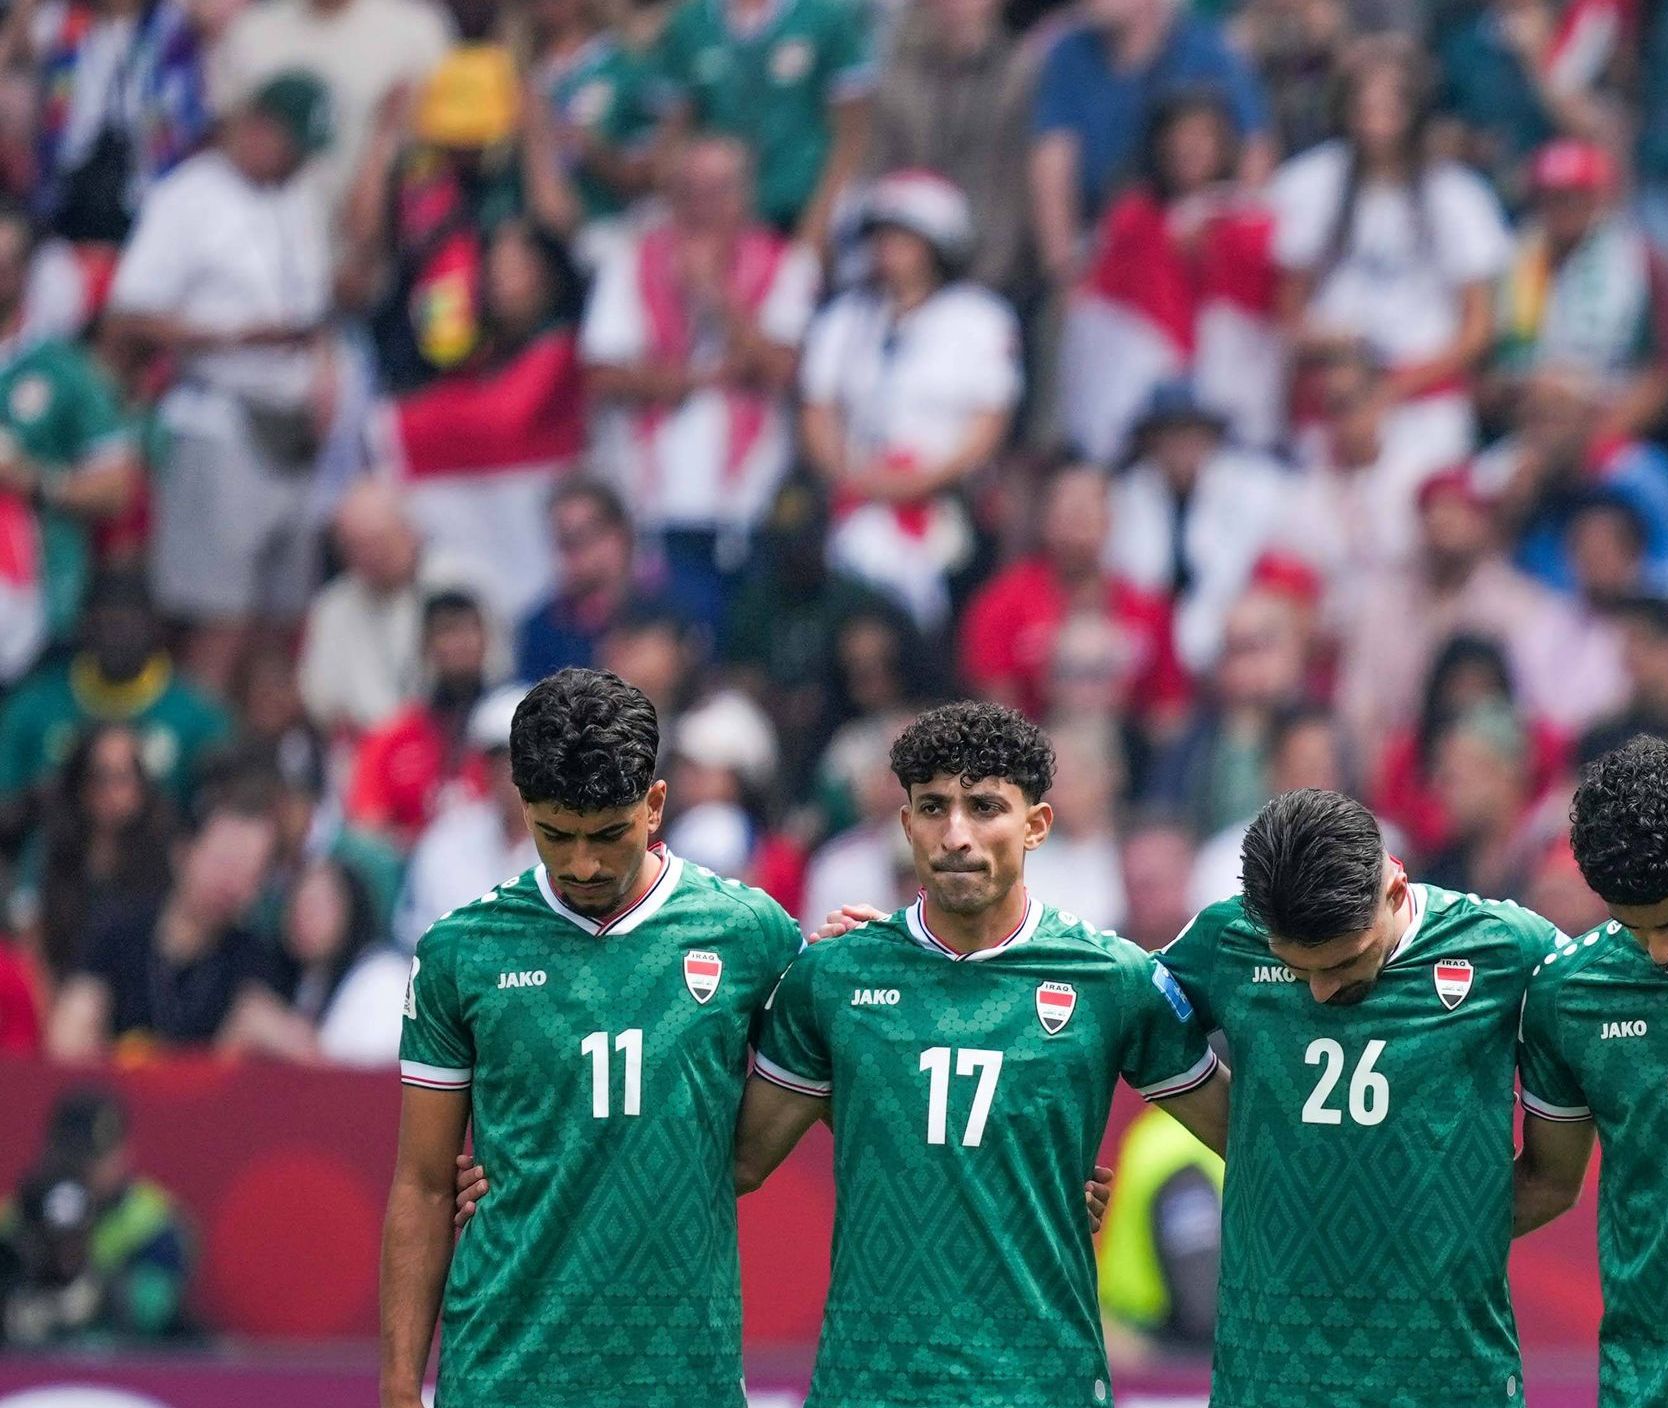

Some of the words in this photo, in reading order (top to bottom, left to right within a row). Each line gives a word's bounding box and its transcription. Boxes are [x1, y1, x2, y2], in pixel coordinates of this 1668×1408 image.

[692, 953, 715, 961] IRAQ
[497, 970, 547, 989] JAKO
[1252, 966, 1296, 983] JAKO
[1045, 983, 1069, 992] IRAQ
[851, 989, 901, 1006] JAKO
[1600, 1020, 1648, 1040] JAKO
[581, 1028, 643, 1118] 11
[1301, 1038, 1390, 1126] 26
[919, 1047, 1004, 1147] 17
